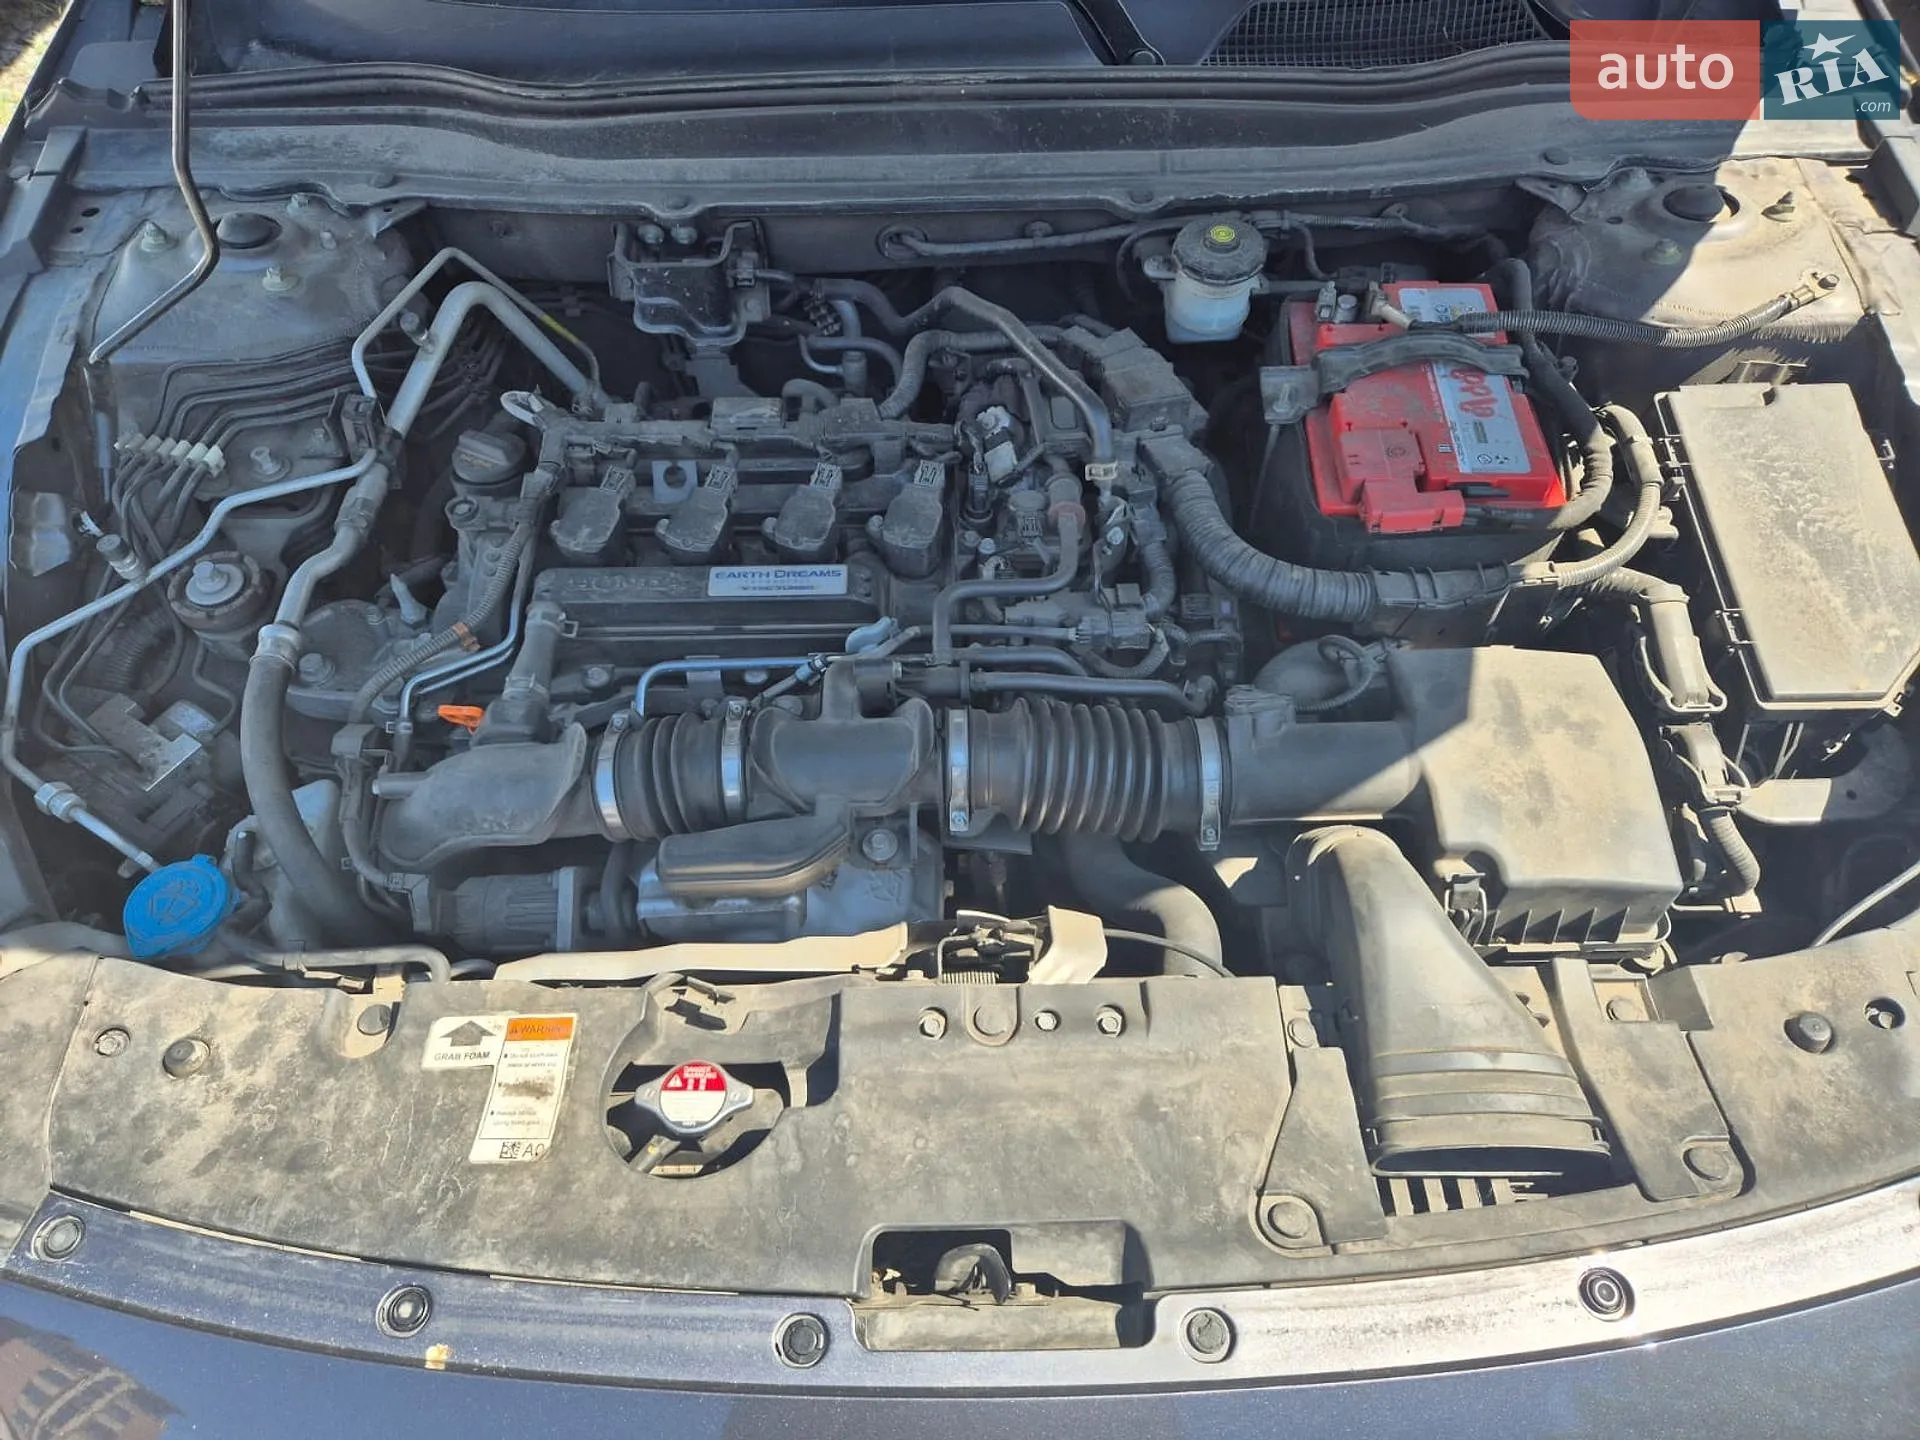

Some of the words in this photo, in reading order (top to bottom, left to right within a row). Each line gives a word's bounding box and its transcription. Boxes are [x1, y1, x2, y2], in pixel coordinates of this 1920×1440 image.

[715, 570, 770, 579] EARTH
[521, 1023, 566, 1035] WARNIN
[434, 1051, 461, 1061] GRAB
[463, 1051, 491, 1061] FOAM
